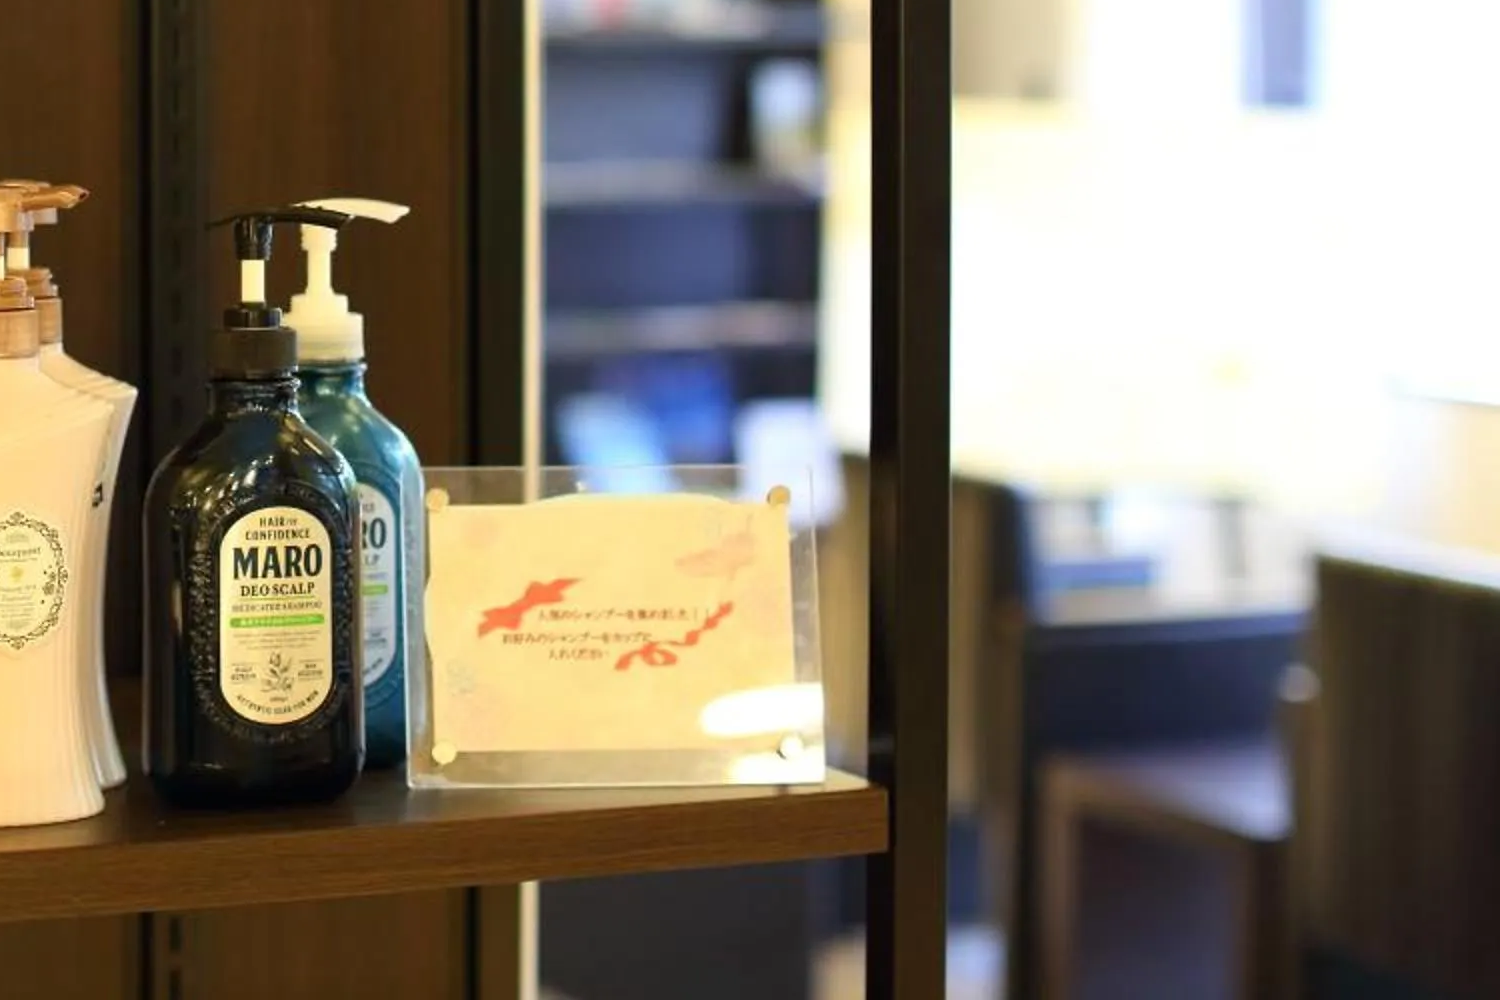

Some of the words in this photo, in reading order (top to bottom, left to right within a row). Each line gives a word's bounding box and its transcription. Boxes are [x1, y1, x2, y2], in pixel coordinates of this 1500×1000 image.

[259, 517, 285, 527] HAIR
[245, 528, 310, 540] CONFIDENCE
[233, 543, 322, 580] MARO
[240, 584, 269, 597] DEO
[272, 581, 315, 596] SCALP
